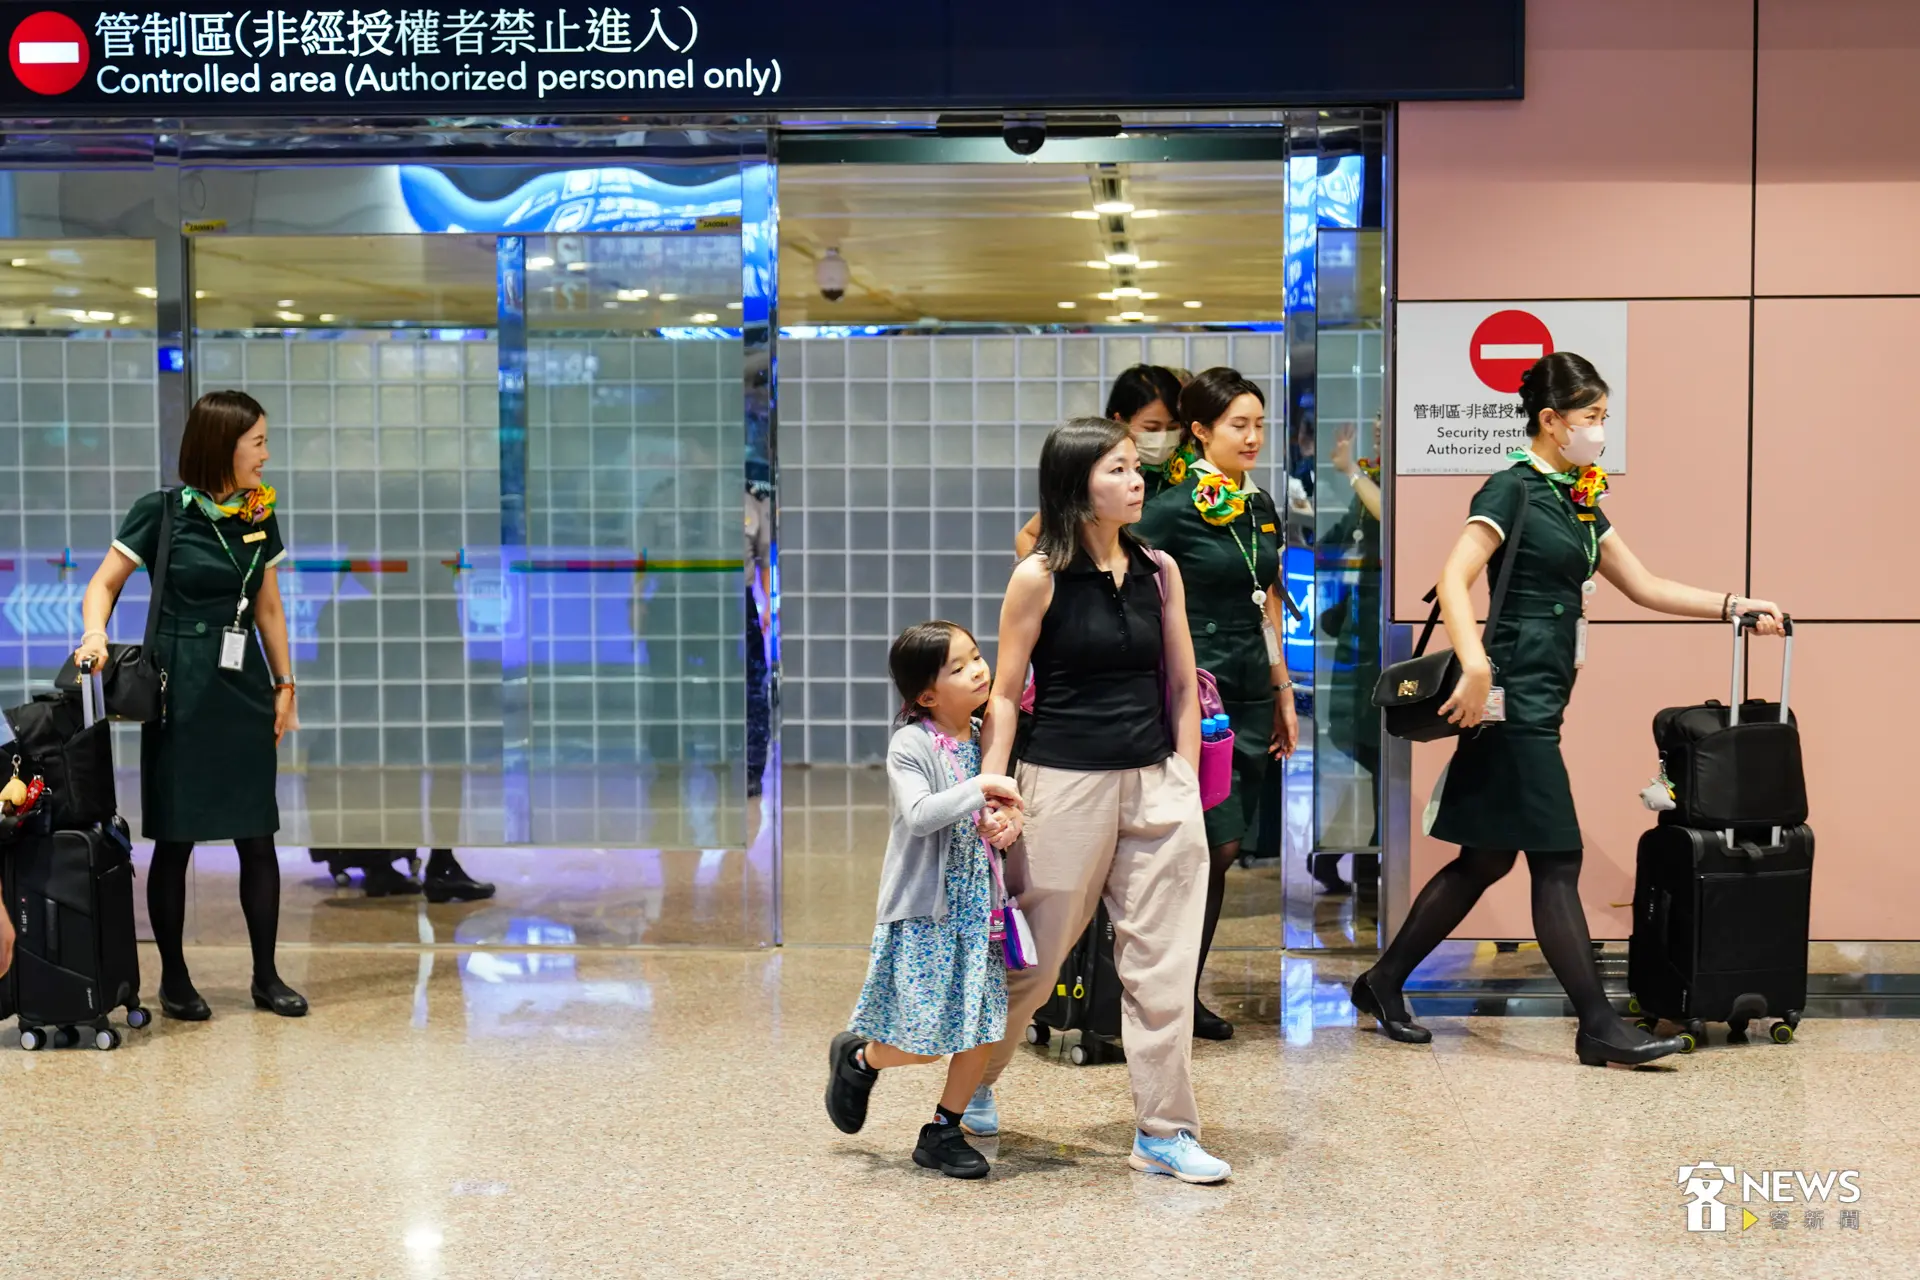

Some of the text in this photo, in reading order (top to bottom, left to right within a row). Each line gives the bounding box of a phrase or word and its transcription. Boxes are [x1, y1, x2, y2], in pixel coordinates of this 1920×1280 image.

[95, 6, 698, 58] 管制區(非經授權者禁止進入)
[96, 58, 782, 98] Controlled area (Authorized personnel only)
[1437, 427, 1526, 441] Security restri
[1427, 443, 1501, 455] Authorized
